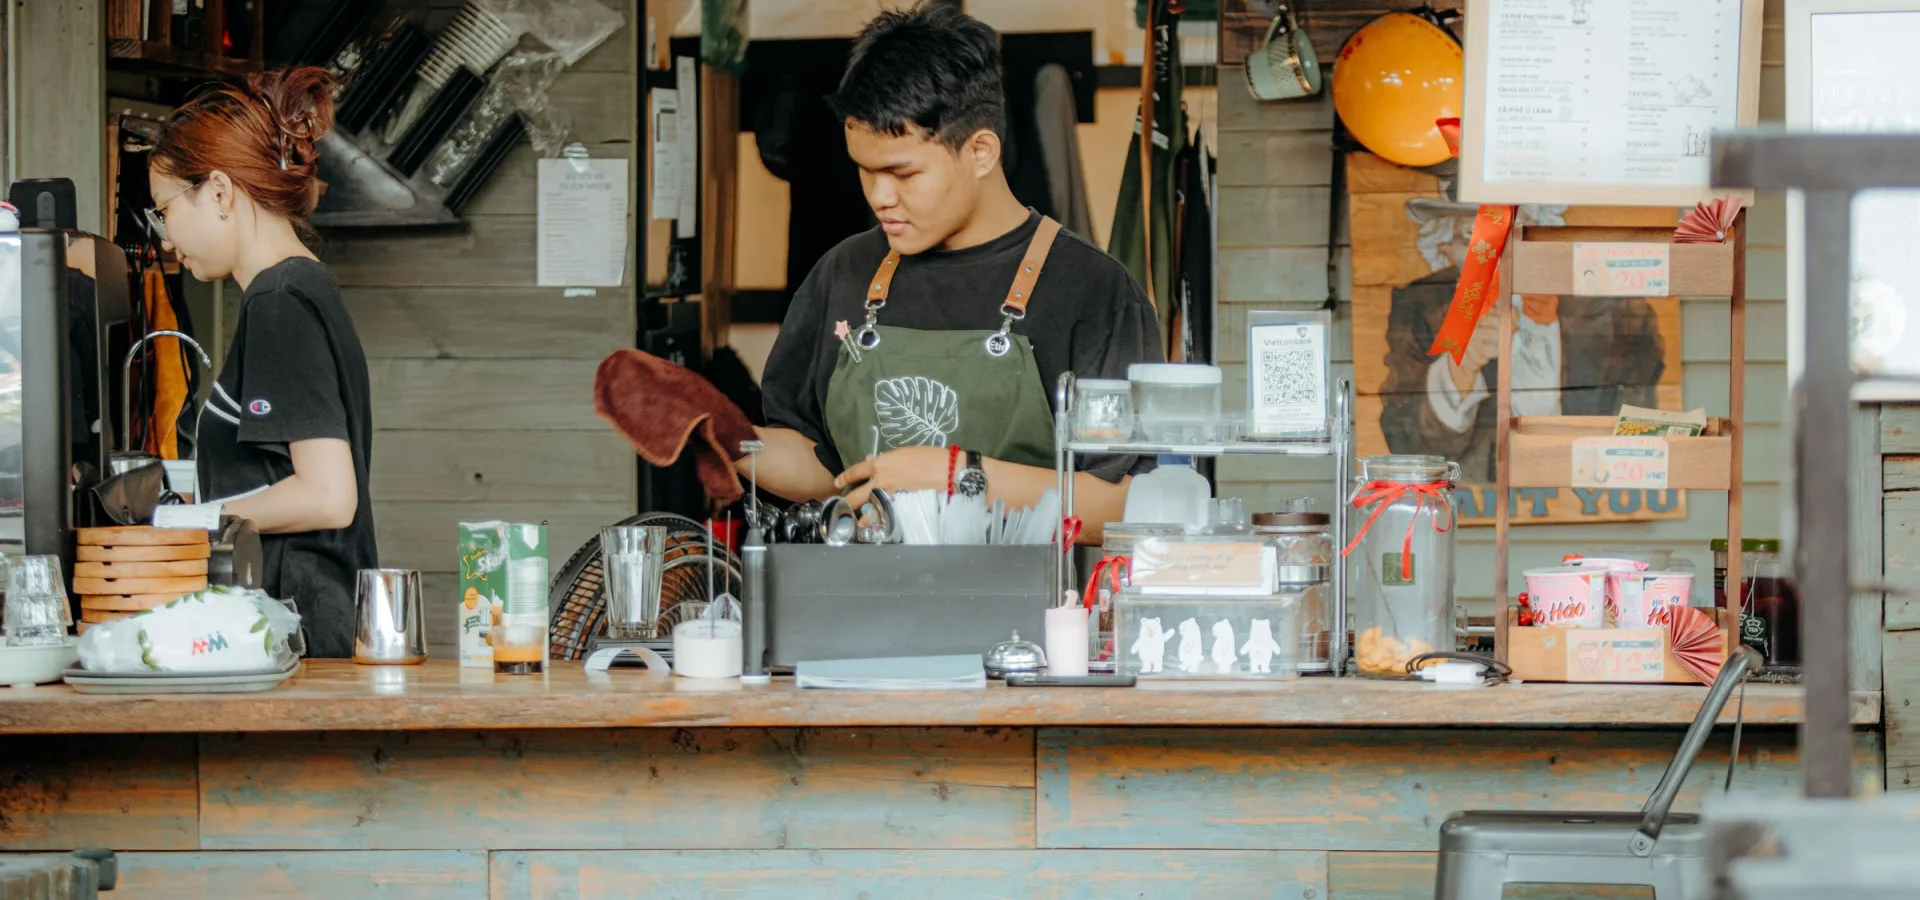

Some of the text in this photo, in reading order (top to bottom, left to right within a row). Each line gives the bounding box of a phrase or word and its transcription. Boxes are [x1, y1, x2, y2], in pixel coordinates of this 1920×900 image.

[1264, 337, 1312, 346] Vietcombank
[1454, 486, 1679, 517] ANT YOU
[1549, 596, 1586, 623] Hảo
